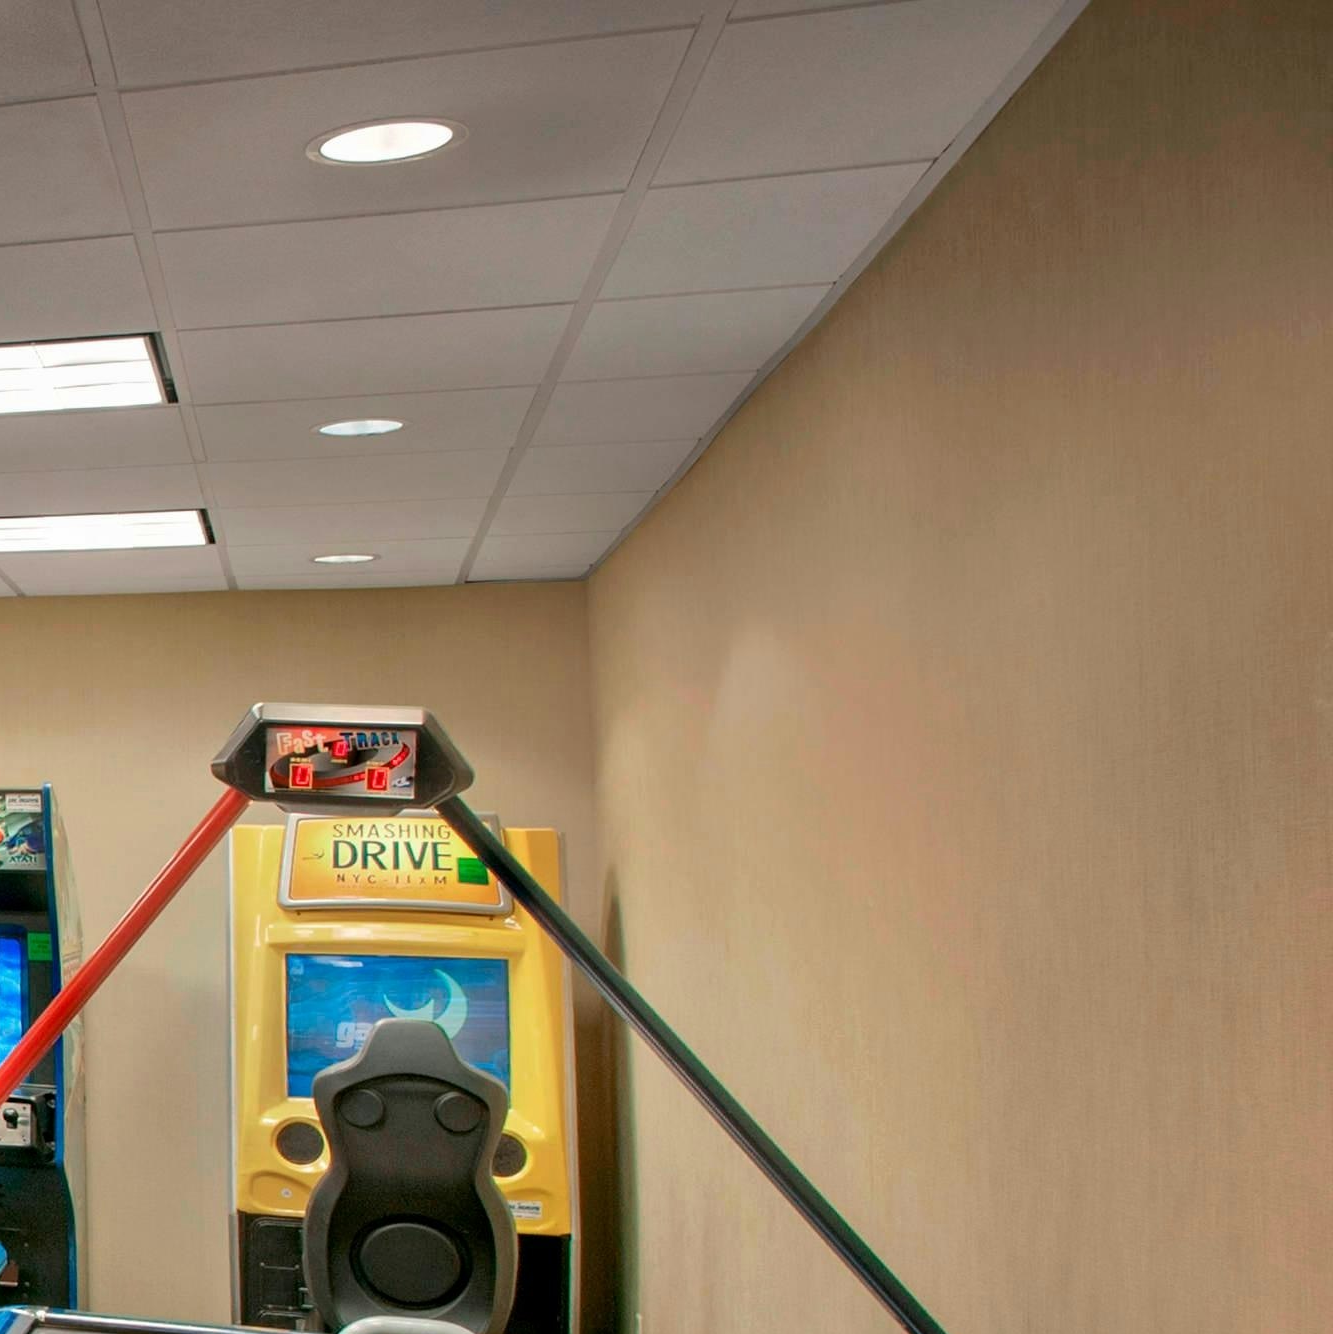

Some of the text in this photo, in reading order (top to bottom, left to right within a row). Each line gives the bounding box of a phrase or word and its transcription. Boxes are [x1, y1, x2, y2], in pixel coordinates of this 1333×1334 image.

[339, 731, 400, 752] TRACK
[333, 823, 451, 840] SMASHING
[333, 840, 453, 871] DRIVE
